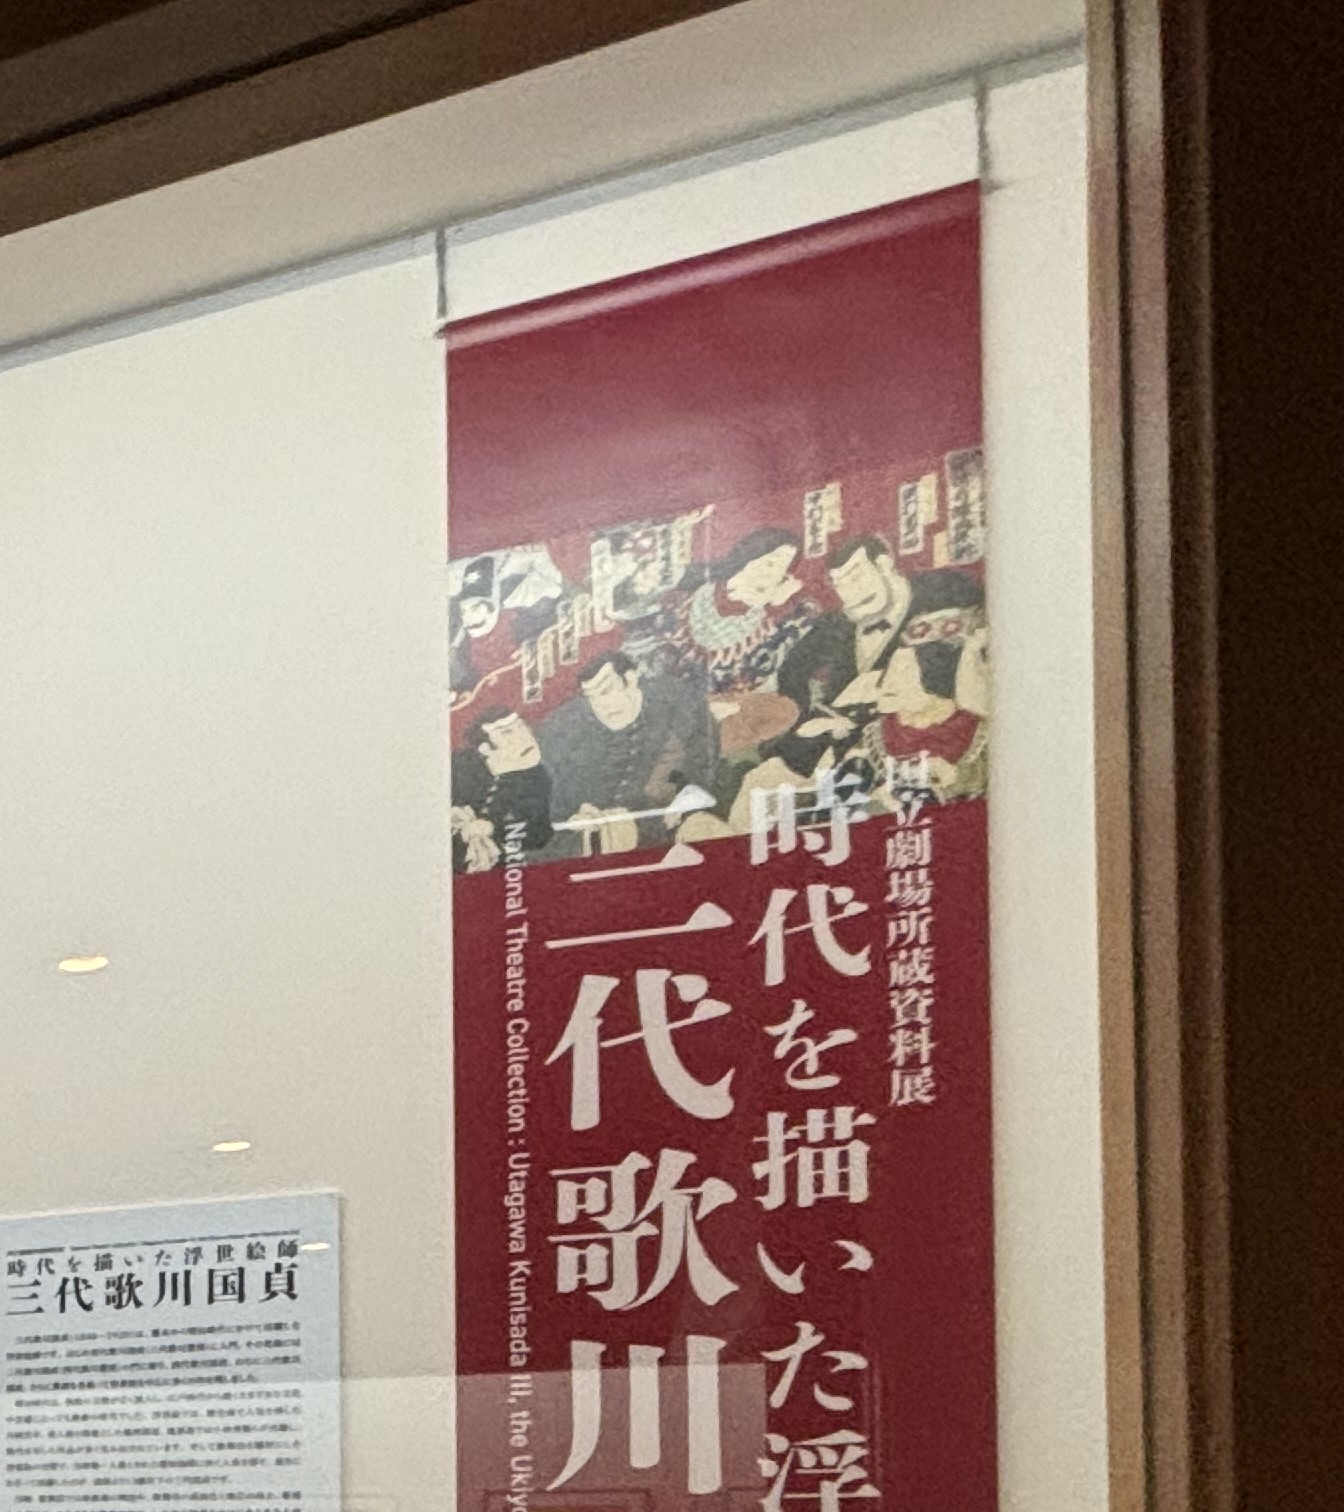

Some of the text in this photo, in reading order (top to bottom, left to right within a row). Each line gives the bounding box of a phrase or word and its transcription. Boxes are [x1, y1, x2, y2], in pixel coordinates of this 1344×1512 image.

[503, 821, 529, 918] National
[505, 920, 530, 1013] Theatre
[506, 1017, 531, 1133] Collection
[503, 1152, 531, 1254] Utagawa
[5, 1262, 299, 1316] 三代歌川国貞
[6, 1239, 300, 1277] 時代を描いた浮世絵師
[508, 1261, 533, 1367] Kunisada
[510, 1410, 533, 1448] the
